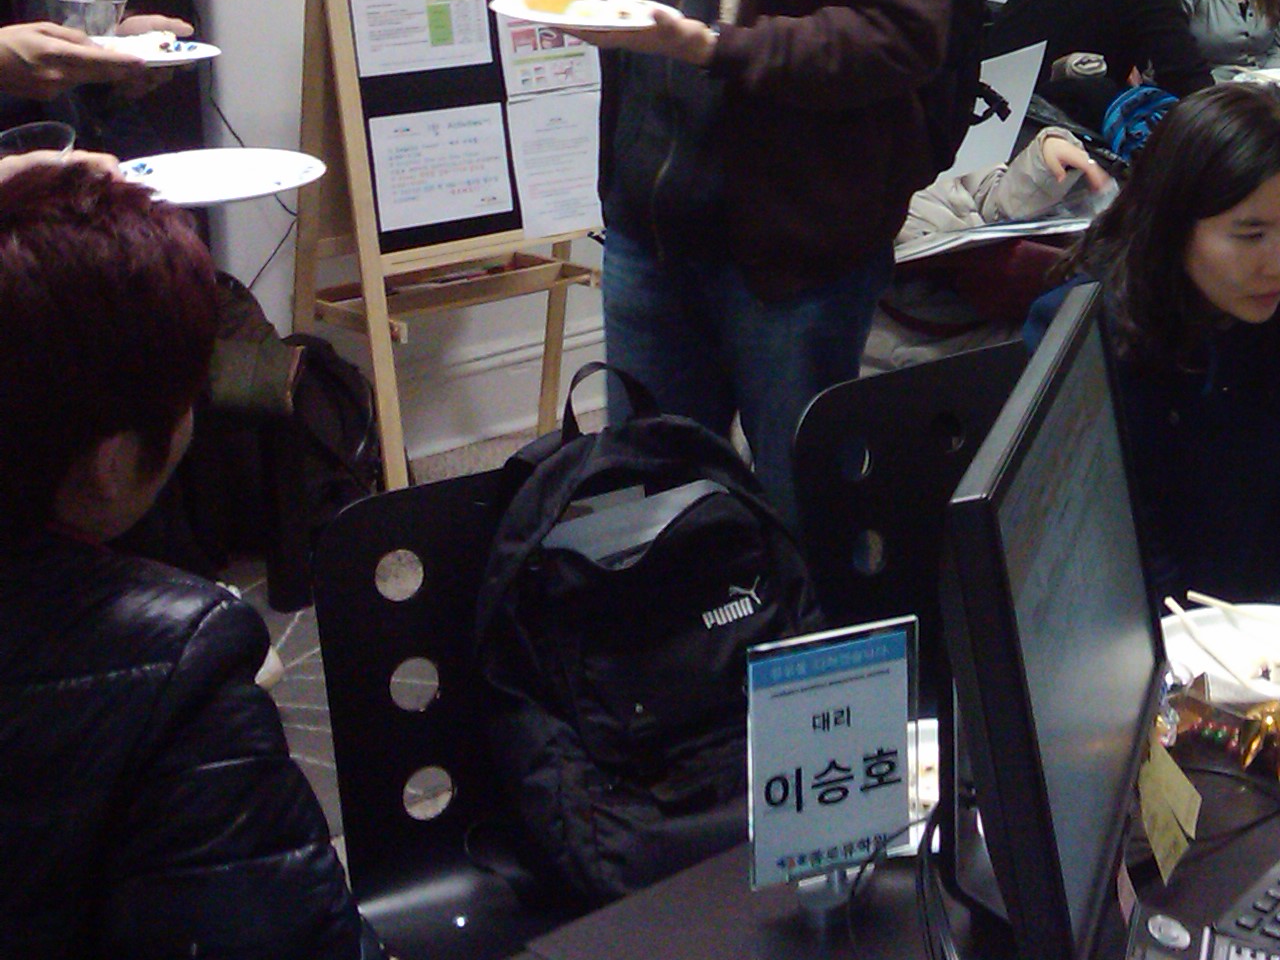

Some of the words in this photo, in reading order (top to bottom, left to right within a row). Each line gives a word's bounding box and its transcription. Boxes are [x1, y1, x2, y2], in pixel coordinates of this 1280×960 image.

[702, 596, 754, 629] PUMA
[811, 705, 851, 733] 대리
[763, 747, 902, 814] 이승호
